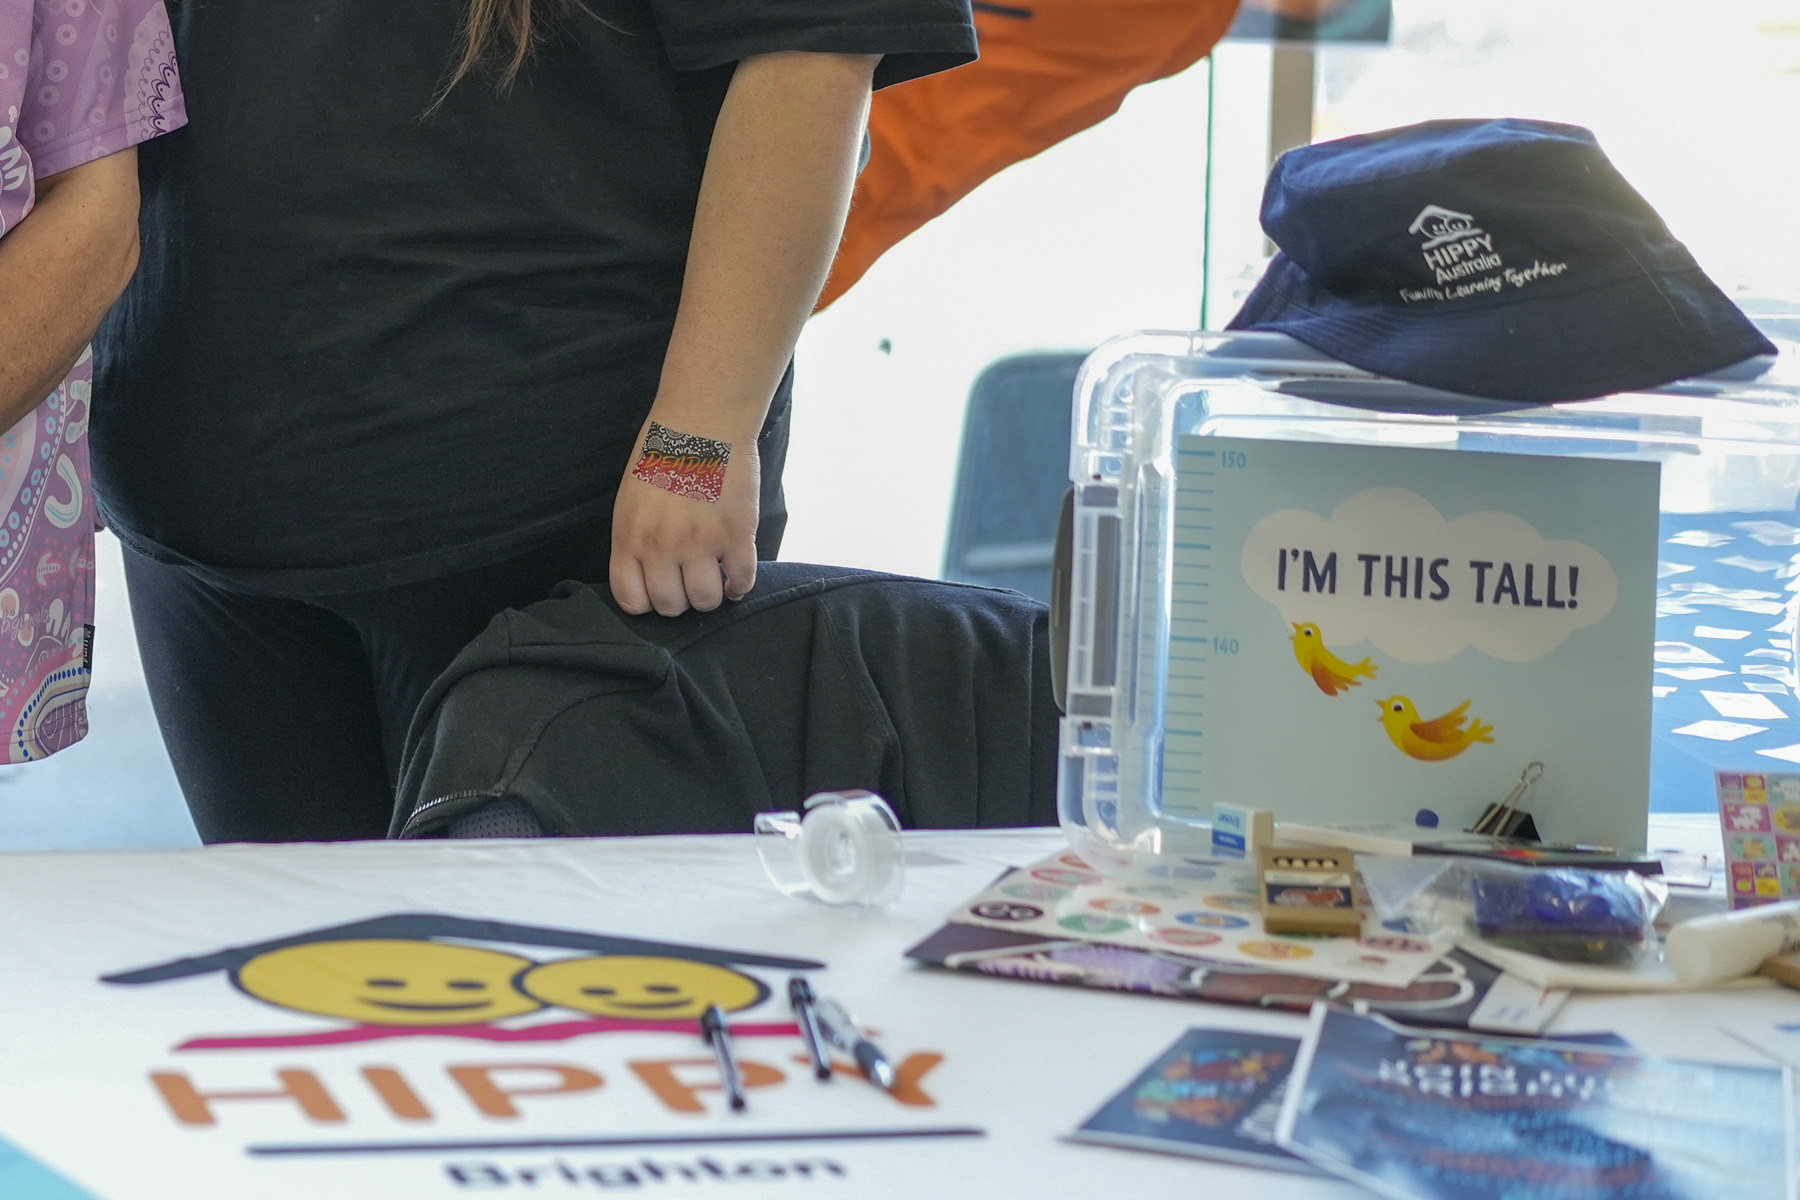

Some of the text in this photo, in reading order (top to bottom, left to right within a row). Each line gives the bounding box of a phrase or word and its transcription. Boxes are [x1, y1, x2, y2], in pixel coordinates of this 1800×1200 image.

[1423, 233, 1494, 271] HIPPY
[1435, 252, 1502, 286] Australia
[1445, 275, 1502, 300] Learning
[1502, 260, 1568, 288] Together
[641, 450, 723, 476] DEADLY
[1221, 451, 1247, 469] 150
[1277, 548, 1579, 609] I'M THIS TALL!
[1213, 636, 1240, 655] 140
[148, 1051, 945, 1127] HIPPY
[442, 1154, 849, 1191] Brighton
